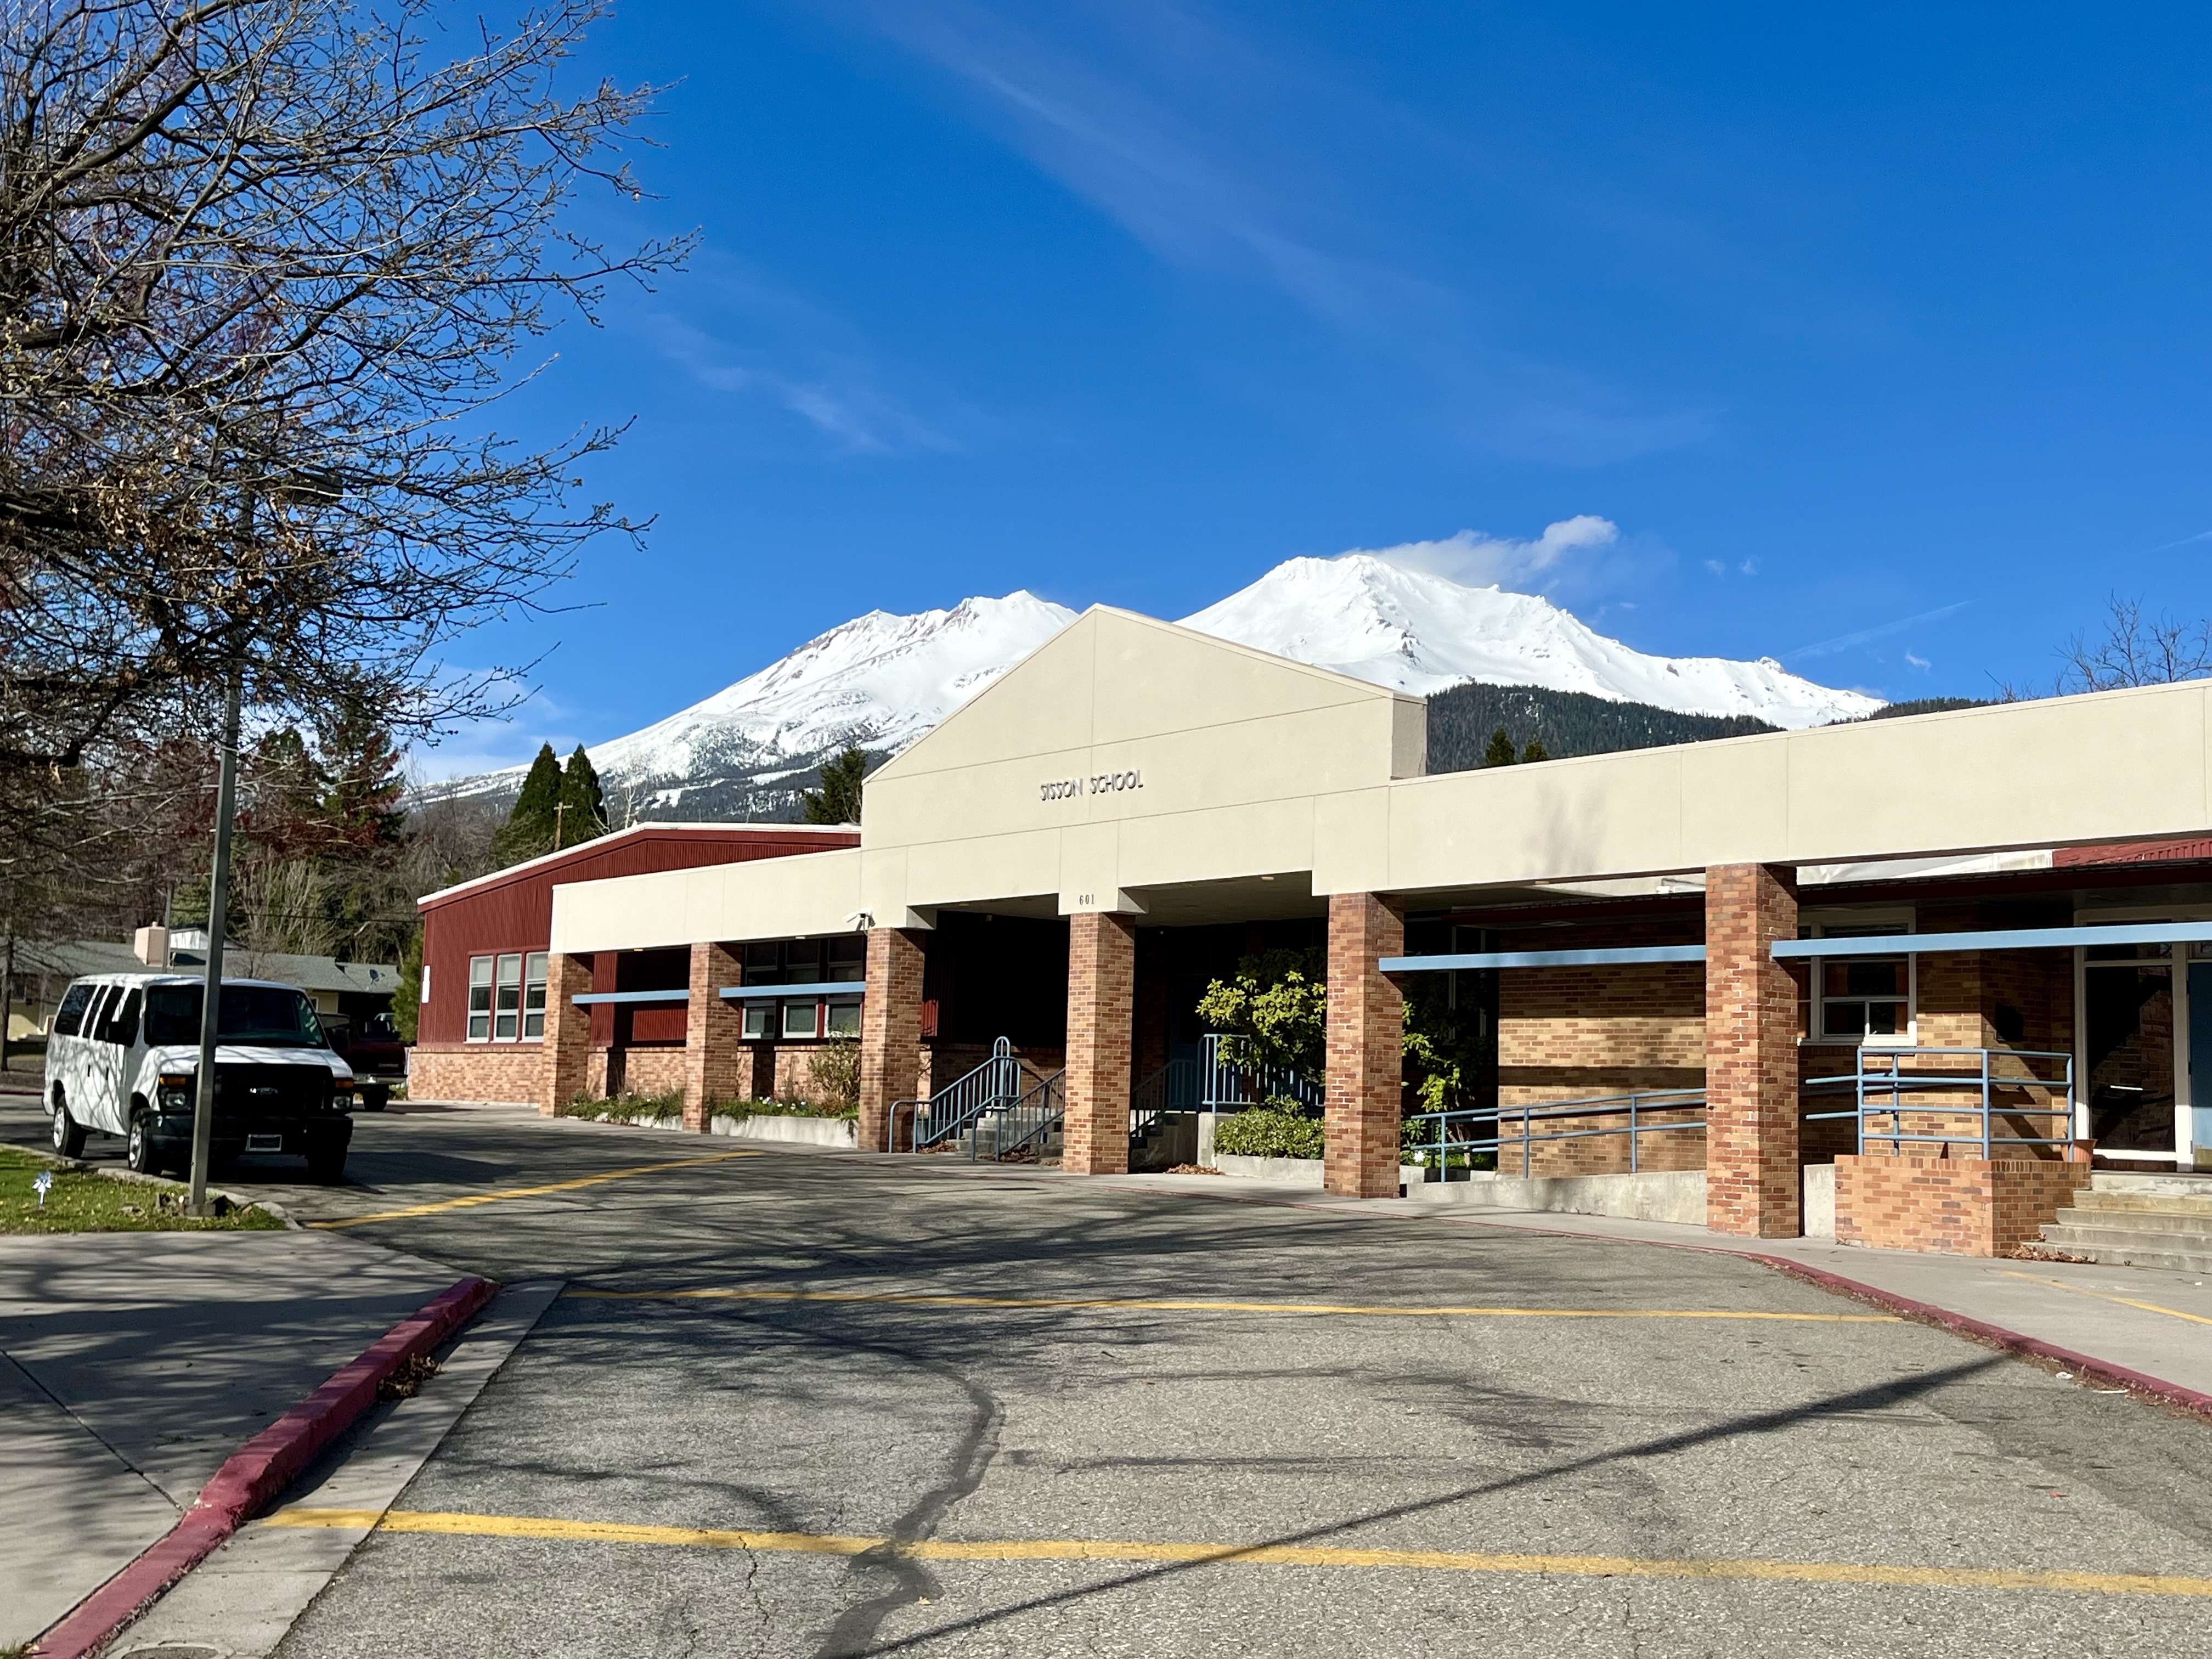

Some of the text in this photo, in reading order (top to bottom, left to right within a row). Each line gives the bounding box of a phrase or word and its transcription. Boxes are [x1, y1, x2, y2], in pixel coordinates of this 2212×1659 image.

[1040, 770, 1143, 801] SISSON SCHOOL
[1079, 894, 1094, 905] 601
